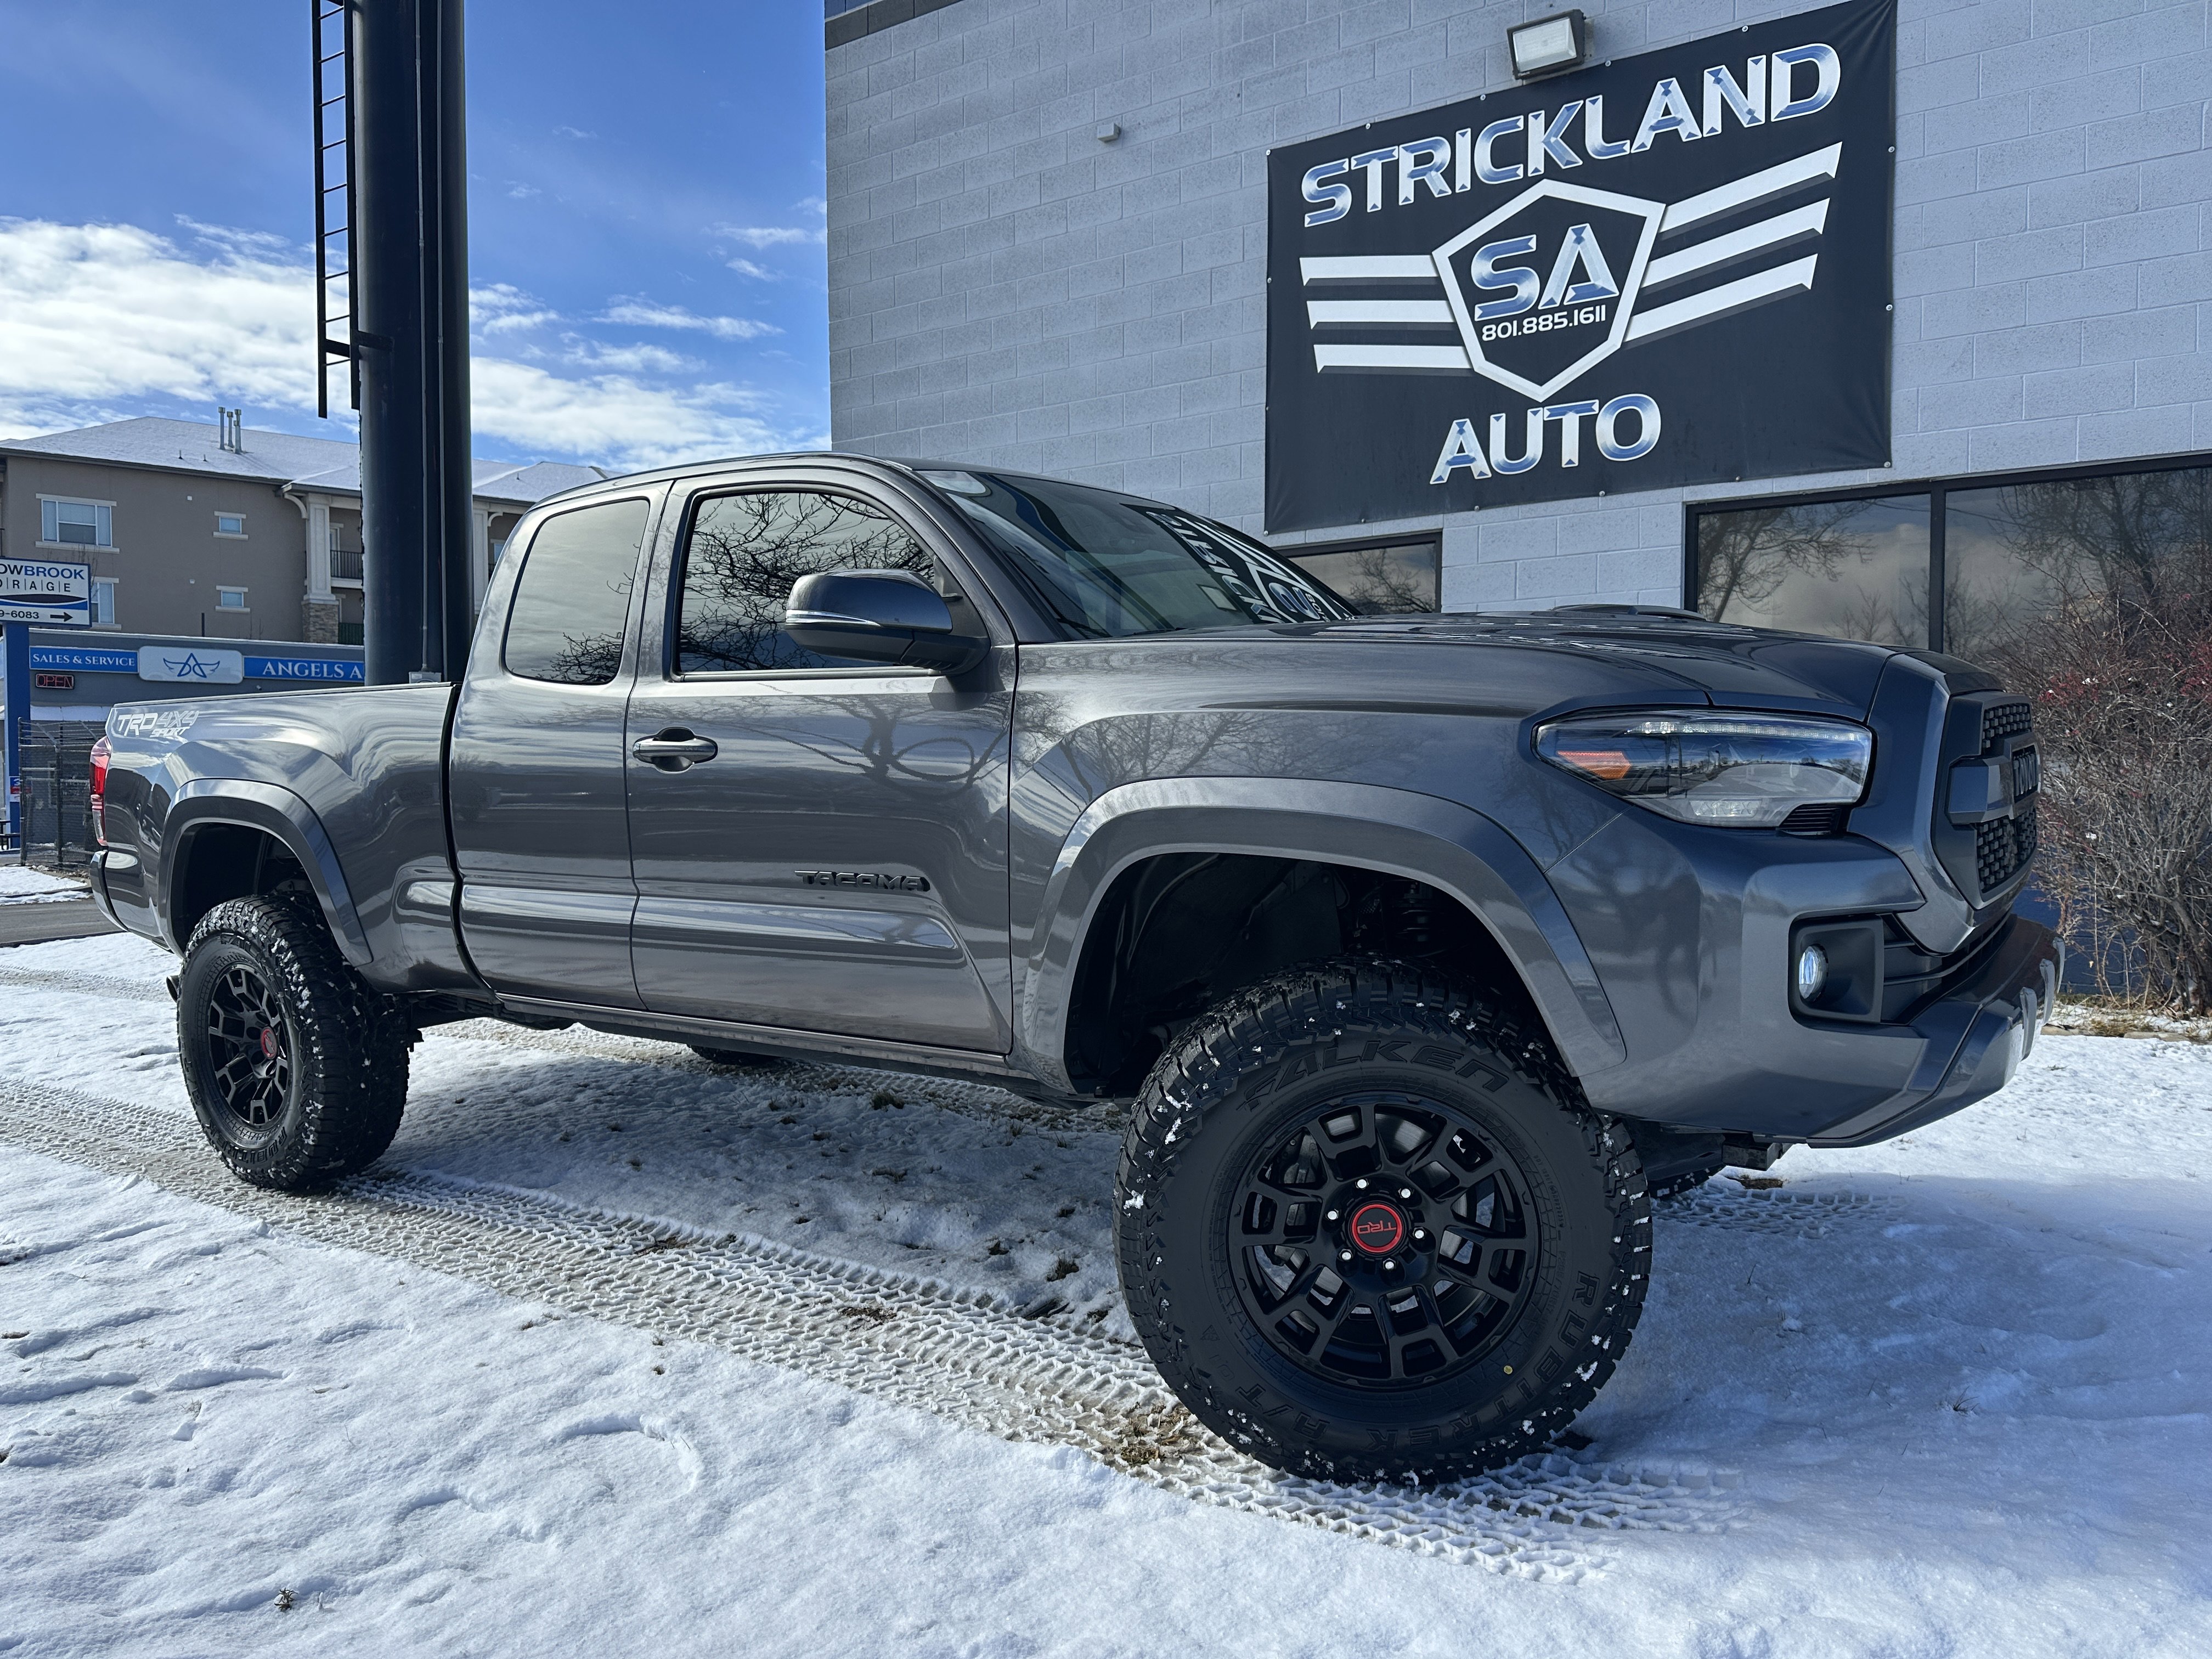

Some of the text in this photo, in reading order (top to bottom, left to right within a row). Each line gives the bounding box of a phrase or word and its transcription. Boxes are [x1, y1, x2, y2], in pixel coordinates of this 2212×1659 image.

[1301, 43, 1842, 227] STRICKLAND
[1471, 223, 1619, 321] SA
[1482, 304, 1606, 341] 801.885.1611
[1430, 394, 1661, 484] AUTO
[32, 654, 135, 666] SALES & SERVICE
[262, 661, 344, 678] ANGELS
[118, 713, 158, 736] TRD
[149, 726, 190, 738] SPORT
[795, 870, 930, 892] TACOMA
[1237, 1041, 1509, 1111] FALKEN
[1357, 1220, 1396, 1234] TRD
[1366, 1271, 1600, 1452] RUBITREK
